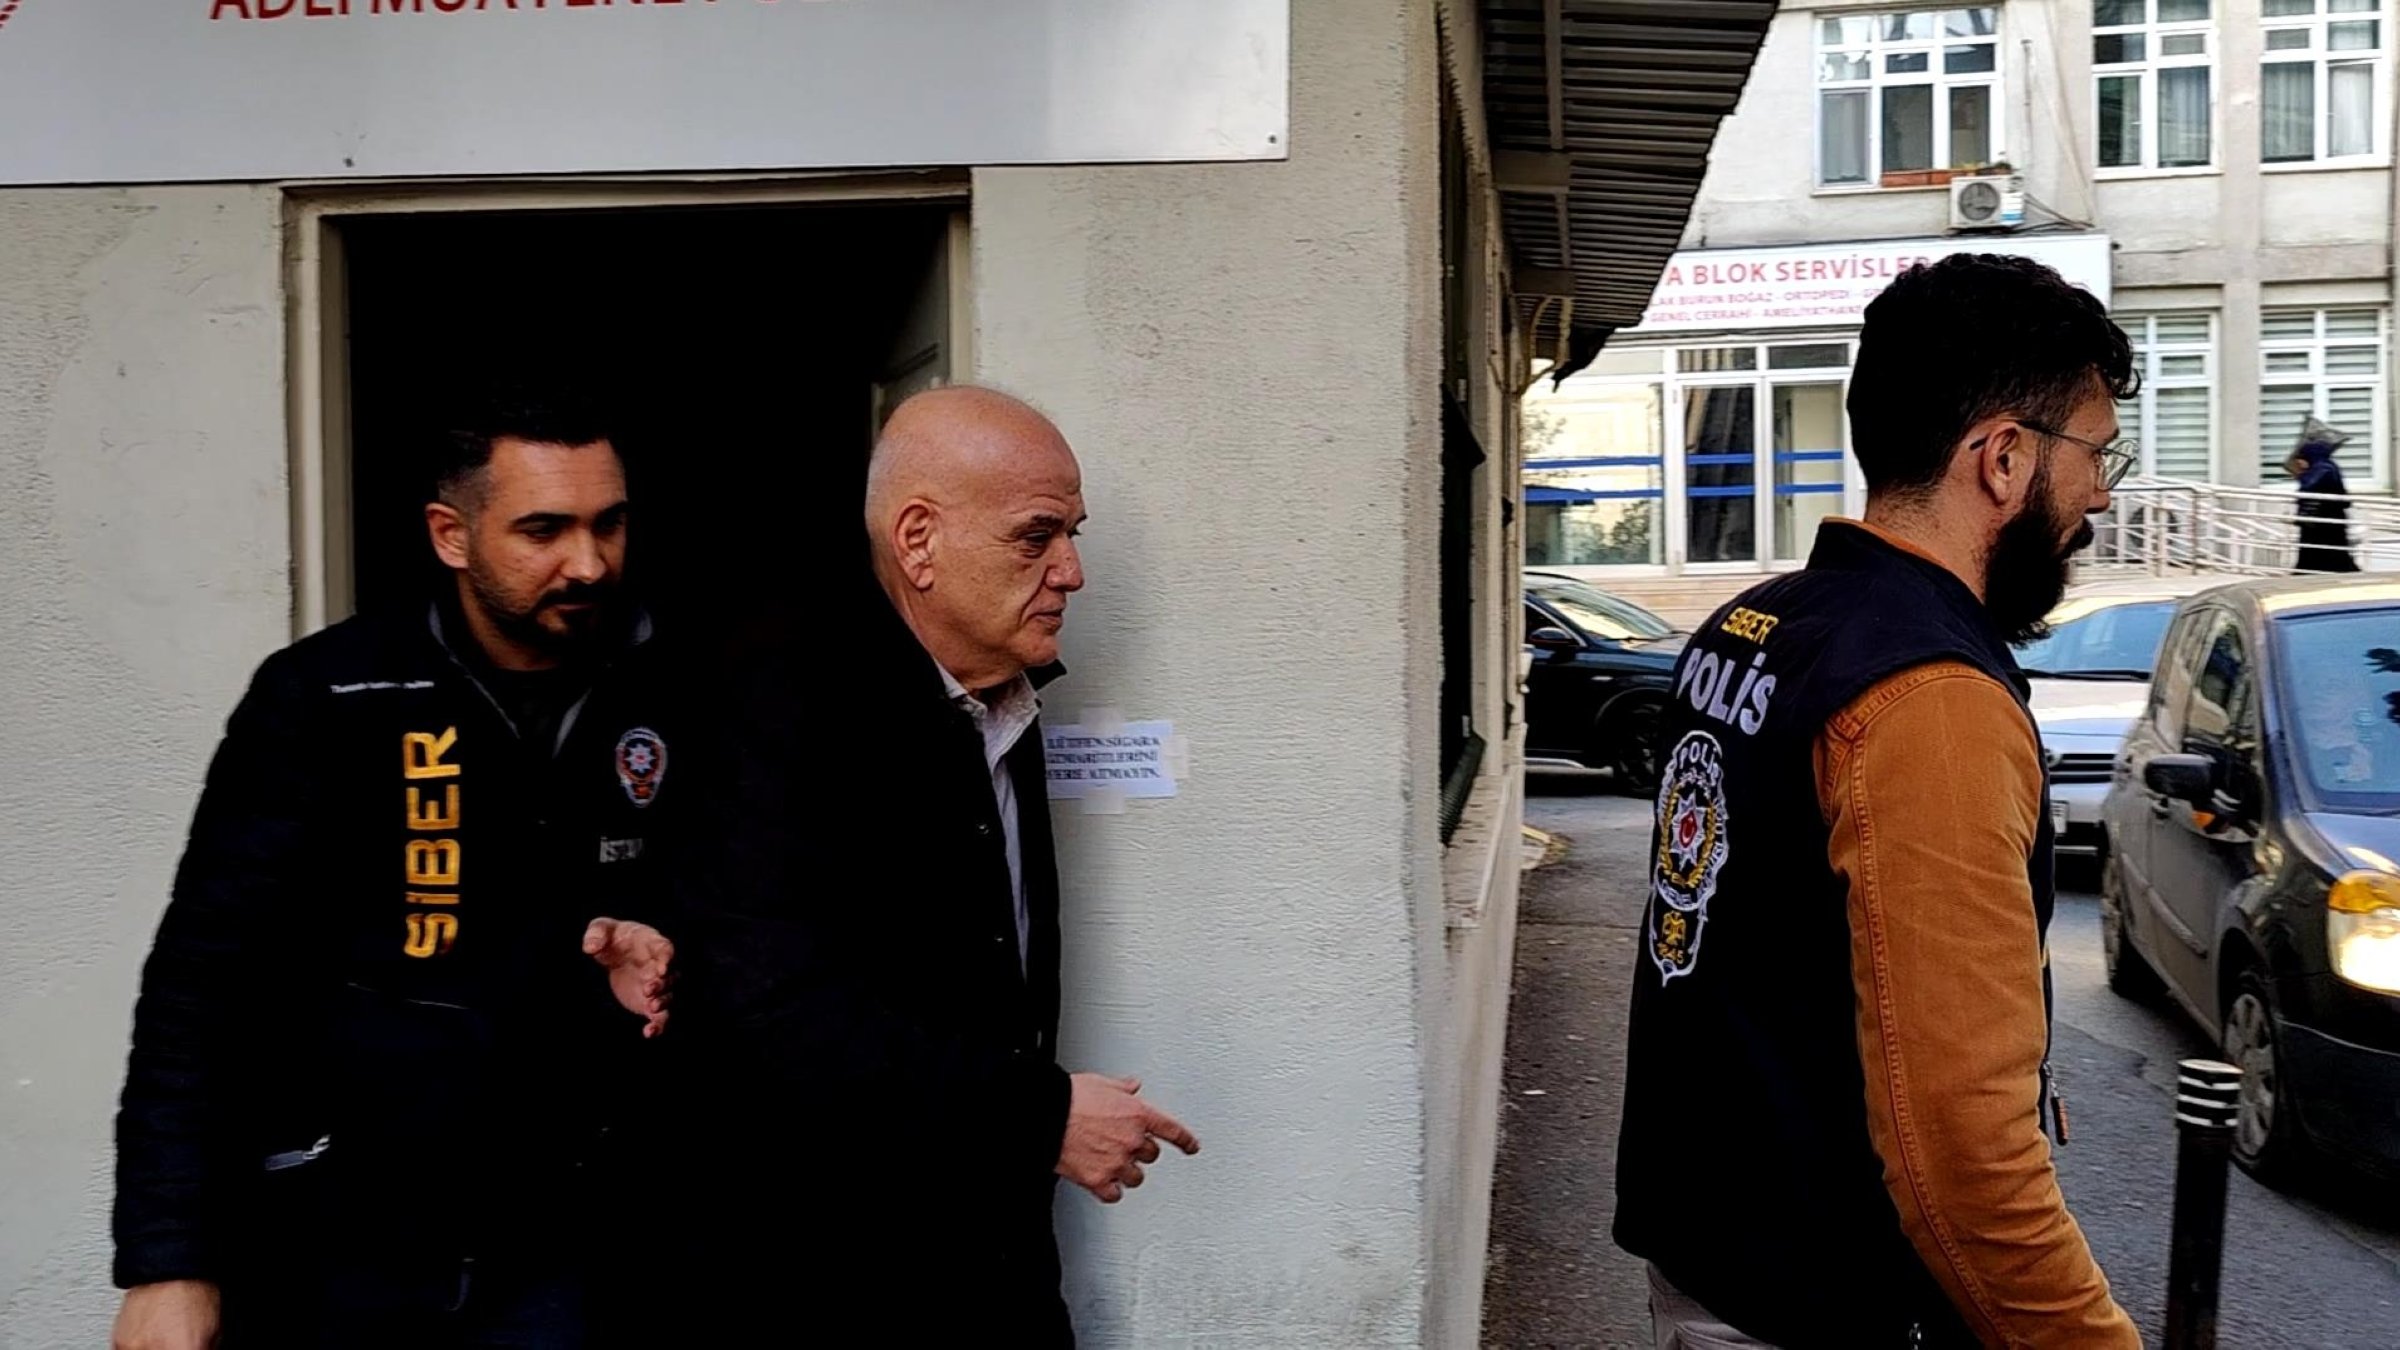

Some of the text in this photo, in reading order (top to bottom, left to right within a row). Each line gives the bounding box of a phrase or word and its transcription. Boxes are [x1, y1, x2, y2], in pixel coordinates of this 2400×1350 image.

[1666, 265, 1684, 286] A
[1693, 262, 1767, 285] BLOK
[1675, 647, 1777, 736] POLİS
